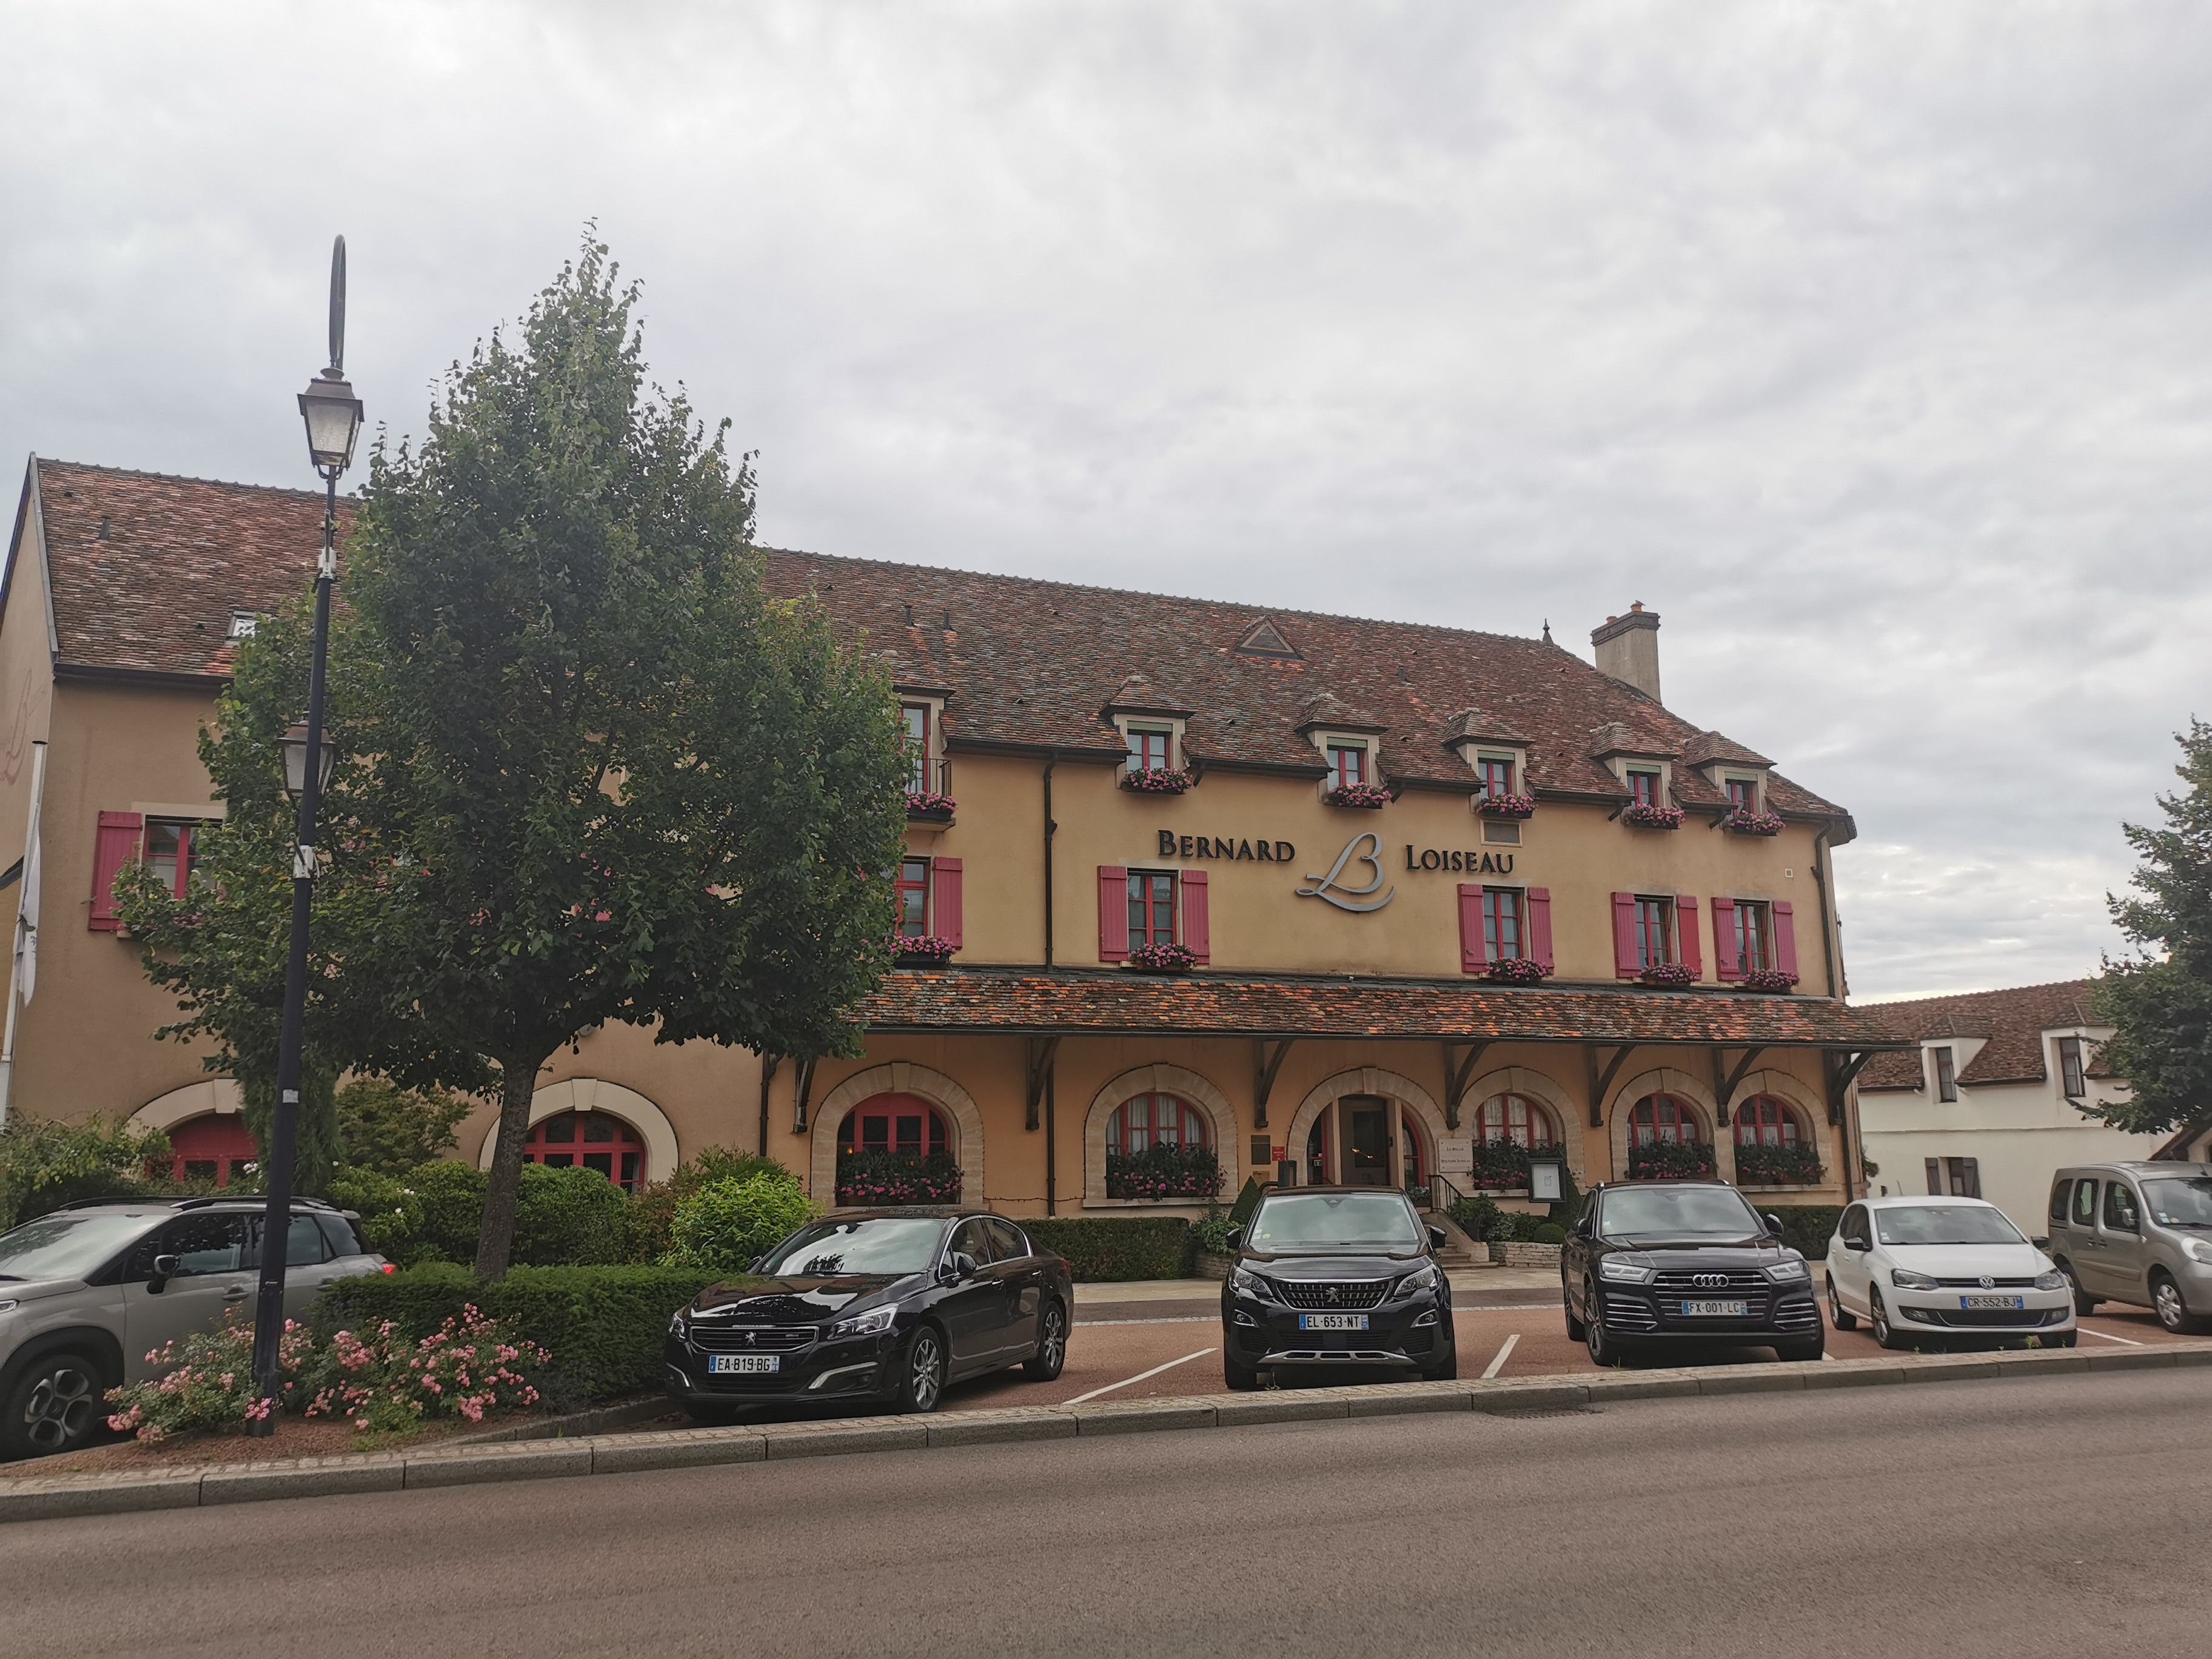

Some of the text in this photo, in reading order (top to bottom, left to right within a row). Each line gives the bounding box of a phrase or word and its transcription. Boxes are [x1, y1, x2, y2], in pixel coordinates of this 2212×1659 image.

[1158, 830, 1295, 862] BERNARD
[1406, 845, 1513, 874] LOISEAU
[1307, 1316, 1359, 1328] EL-653-NT
[717, 1358, 770, 1371] EA-819-BG
